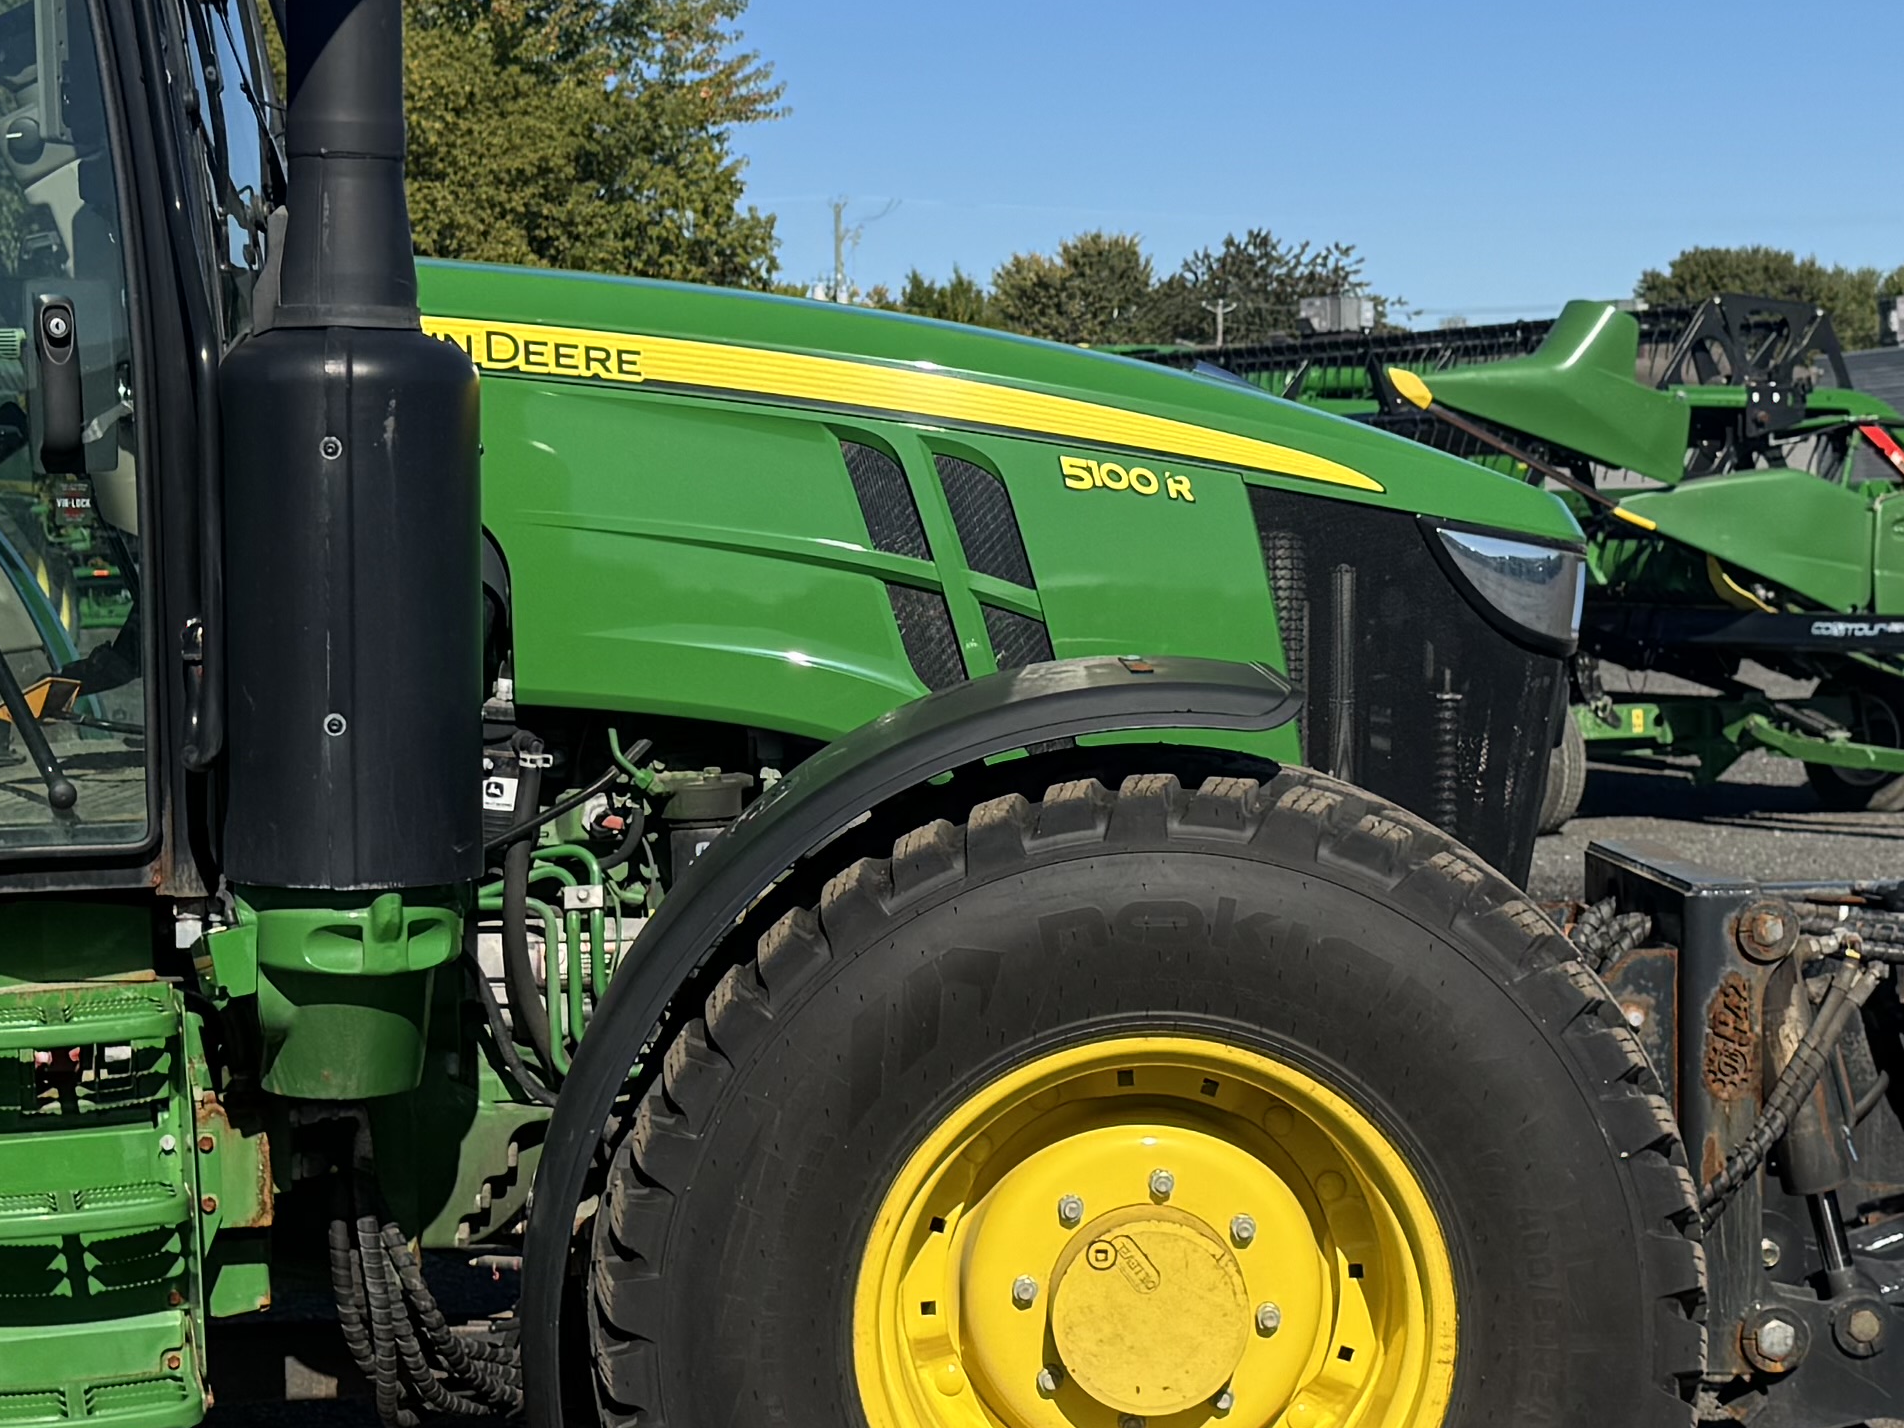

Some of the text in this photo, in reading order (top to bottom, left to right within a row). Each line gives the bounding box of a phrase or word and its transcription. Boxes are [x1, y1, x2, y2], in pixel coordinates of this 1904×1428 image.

[485, 330, 642, 376] DEERE
[1059, 455, 1195, 502] 5100 R
